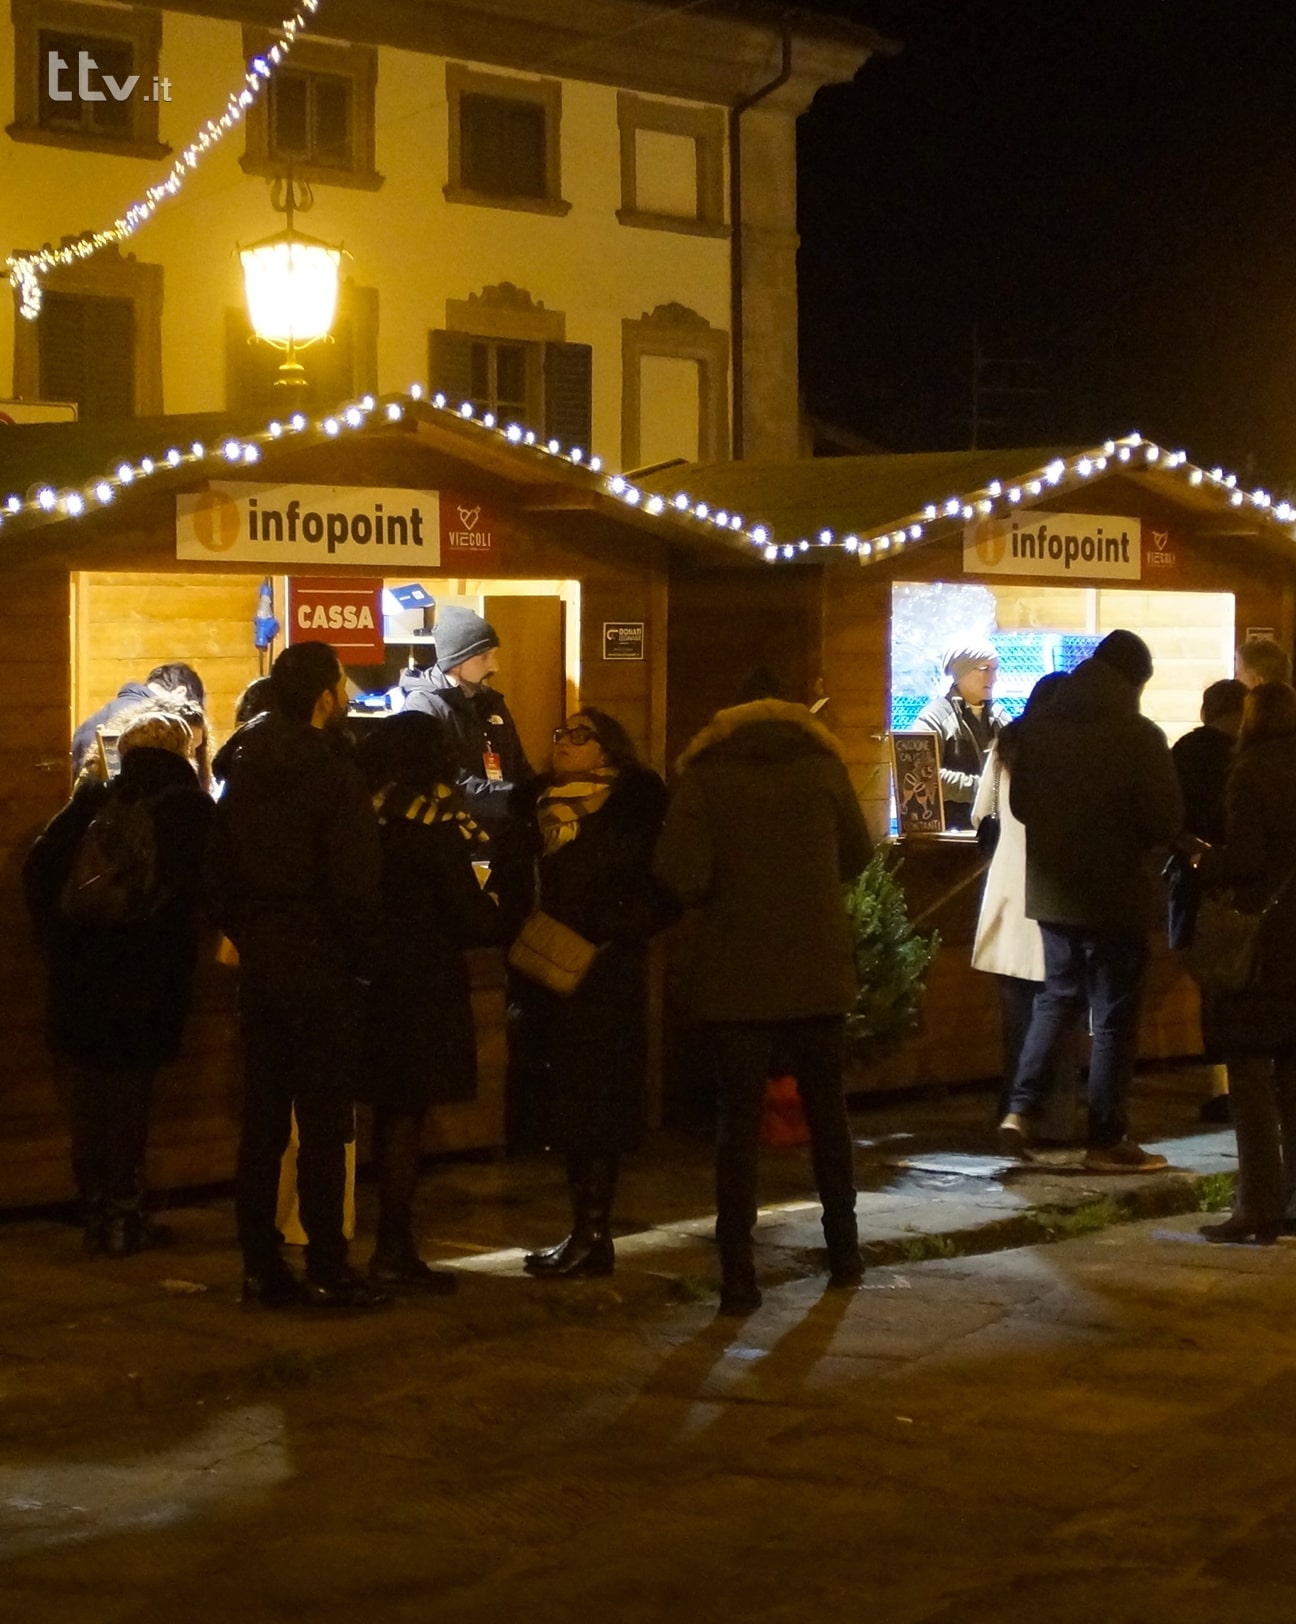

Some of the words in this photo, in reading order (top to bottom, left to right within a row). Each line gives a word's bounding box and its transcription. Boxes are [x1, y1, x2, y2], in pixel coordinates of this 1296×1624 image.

[249, 498, 423, 553] infopoint
[1012, 523, 1130, 569] infopoint
[297, 604, 374, 631] CASSA
